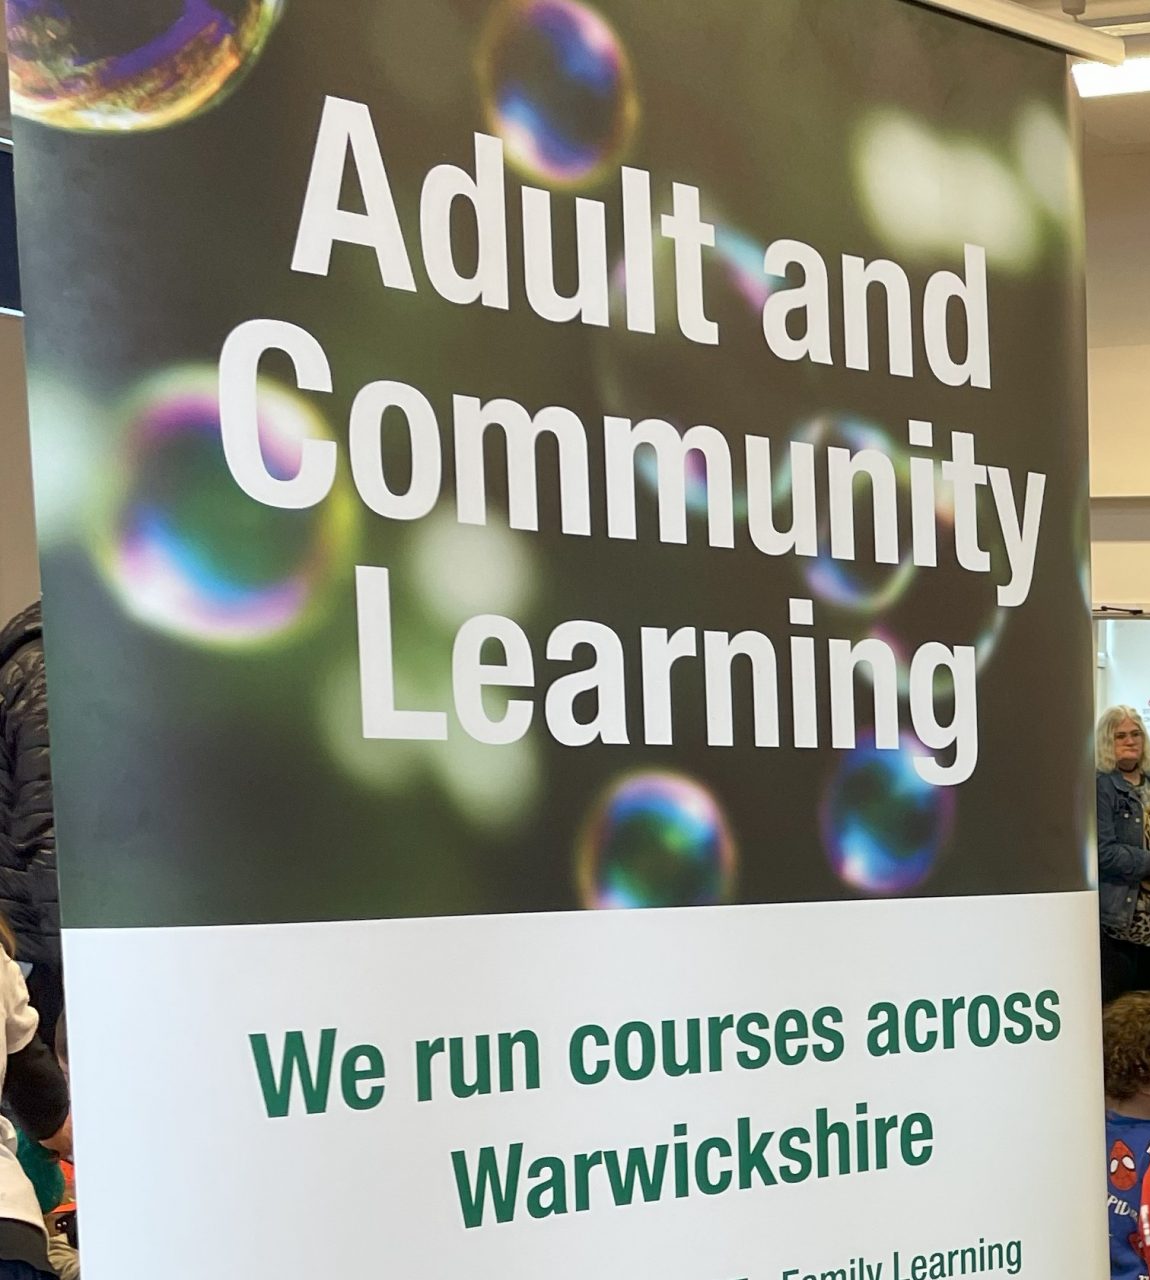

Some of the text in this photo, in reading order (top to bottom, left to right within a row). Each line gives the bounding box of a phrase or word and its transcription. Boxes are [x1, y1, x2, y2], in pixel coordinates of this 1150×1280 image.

[290, 94, 993, 389] Adult and
[218, 317, 1045, 607] Community
[356, 565, 980, 786] Learning
[249, 988, 1062, 1119] We run courses across
[451, 1101, 935, 1230] Warwickshire
